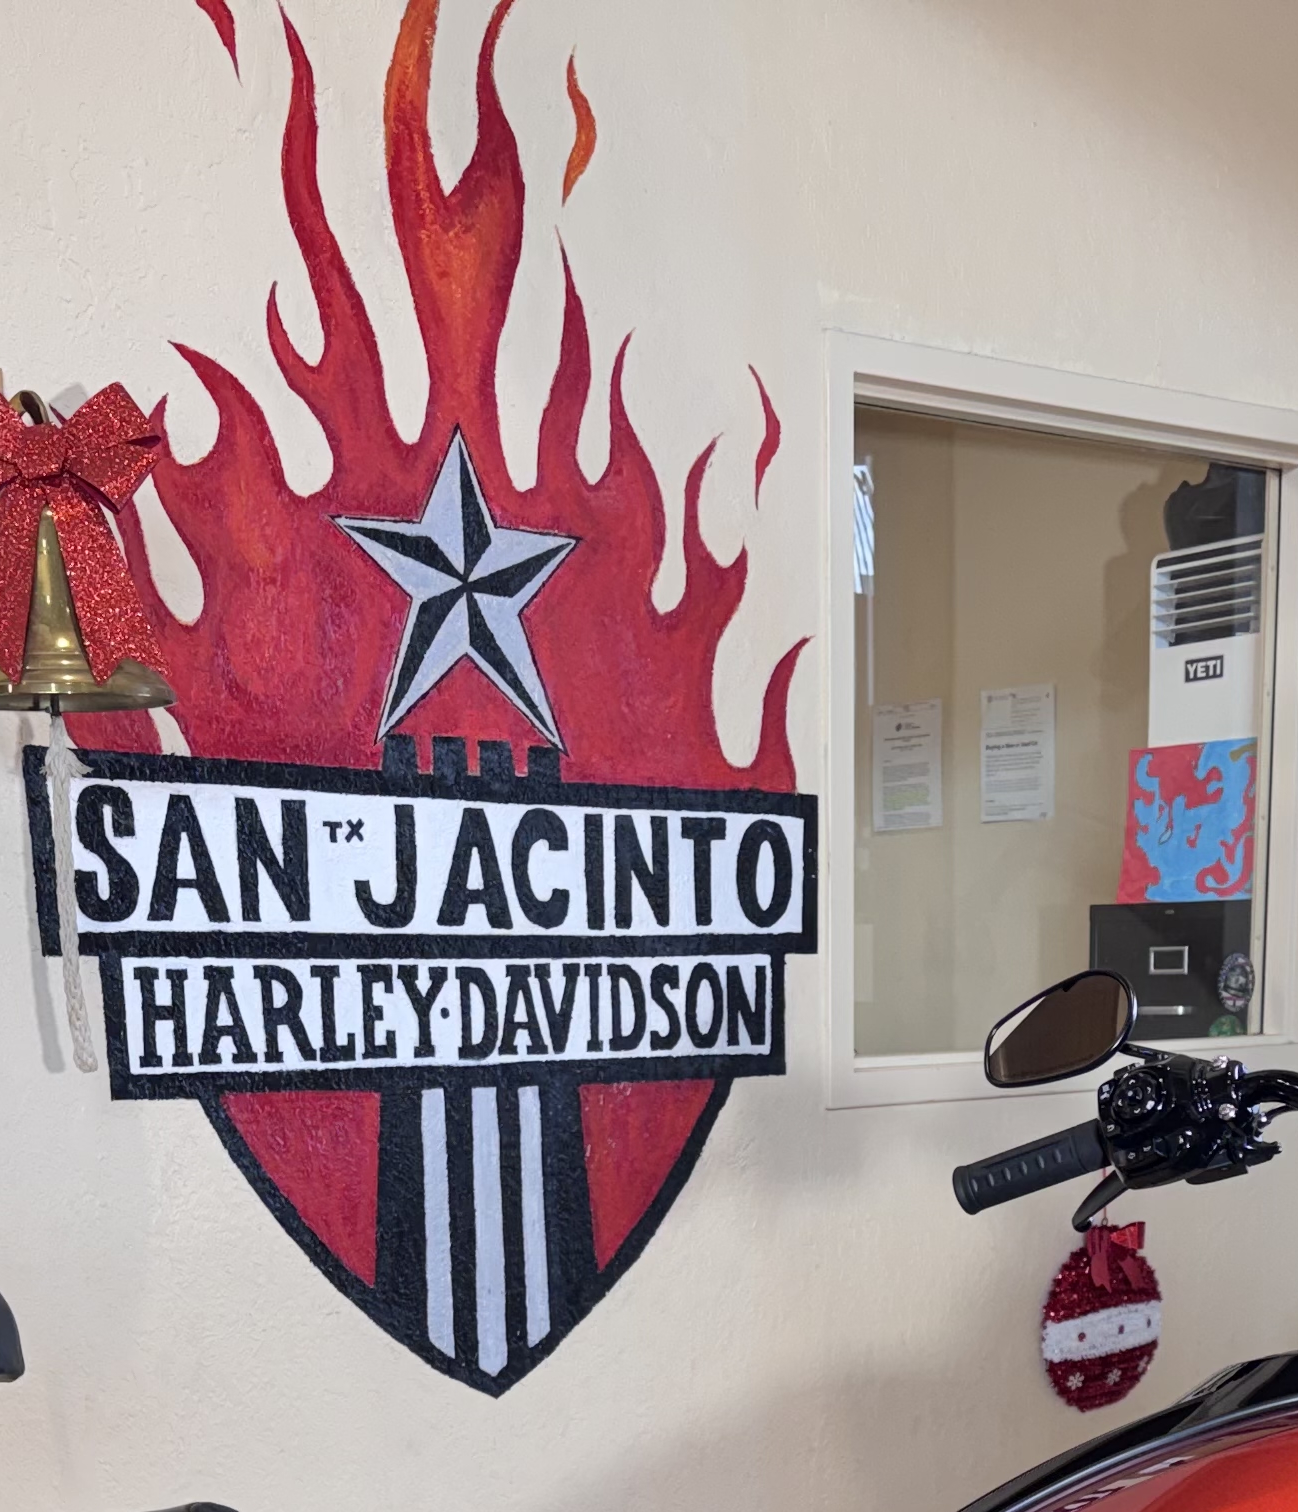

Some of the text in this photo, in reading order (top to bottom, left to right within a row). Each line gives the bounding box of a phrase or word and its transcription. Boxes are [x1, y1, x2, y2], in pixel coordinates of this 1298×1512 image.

[1186, 659, 1221, 680] YETI
[75, 783, 794, 931] SAN TX JACINTO
